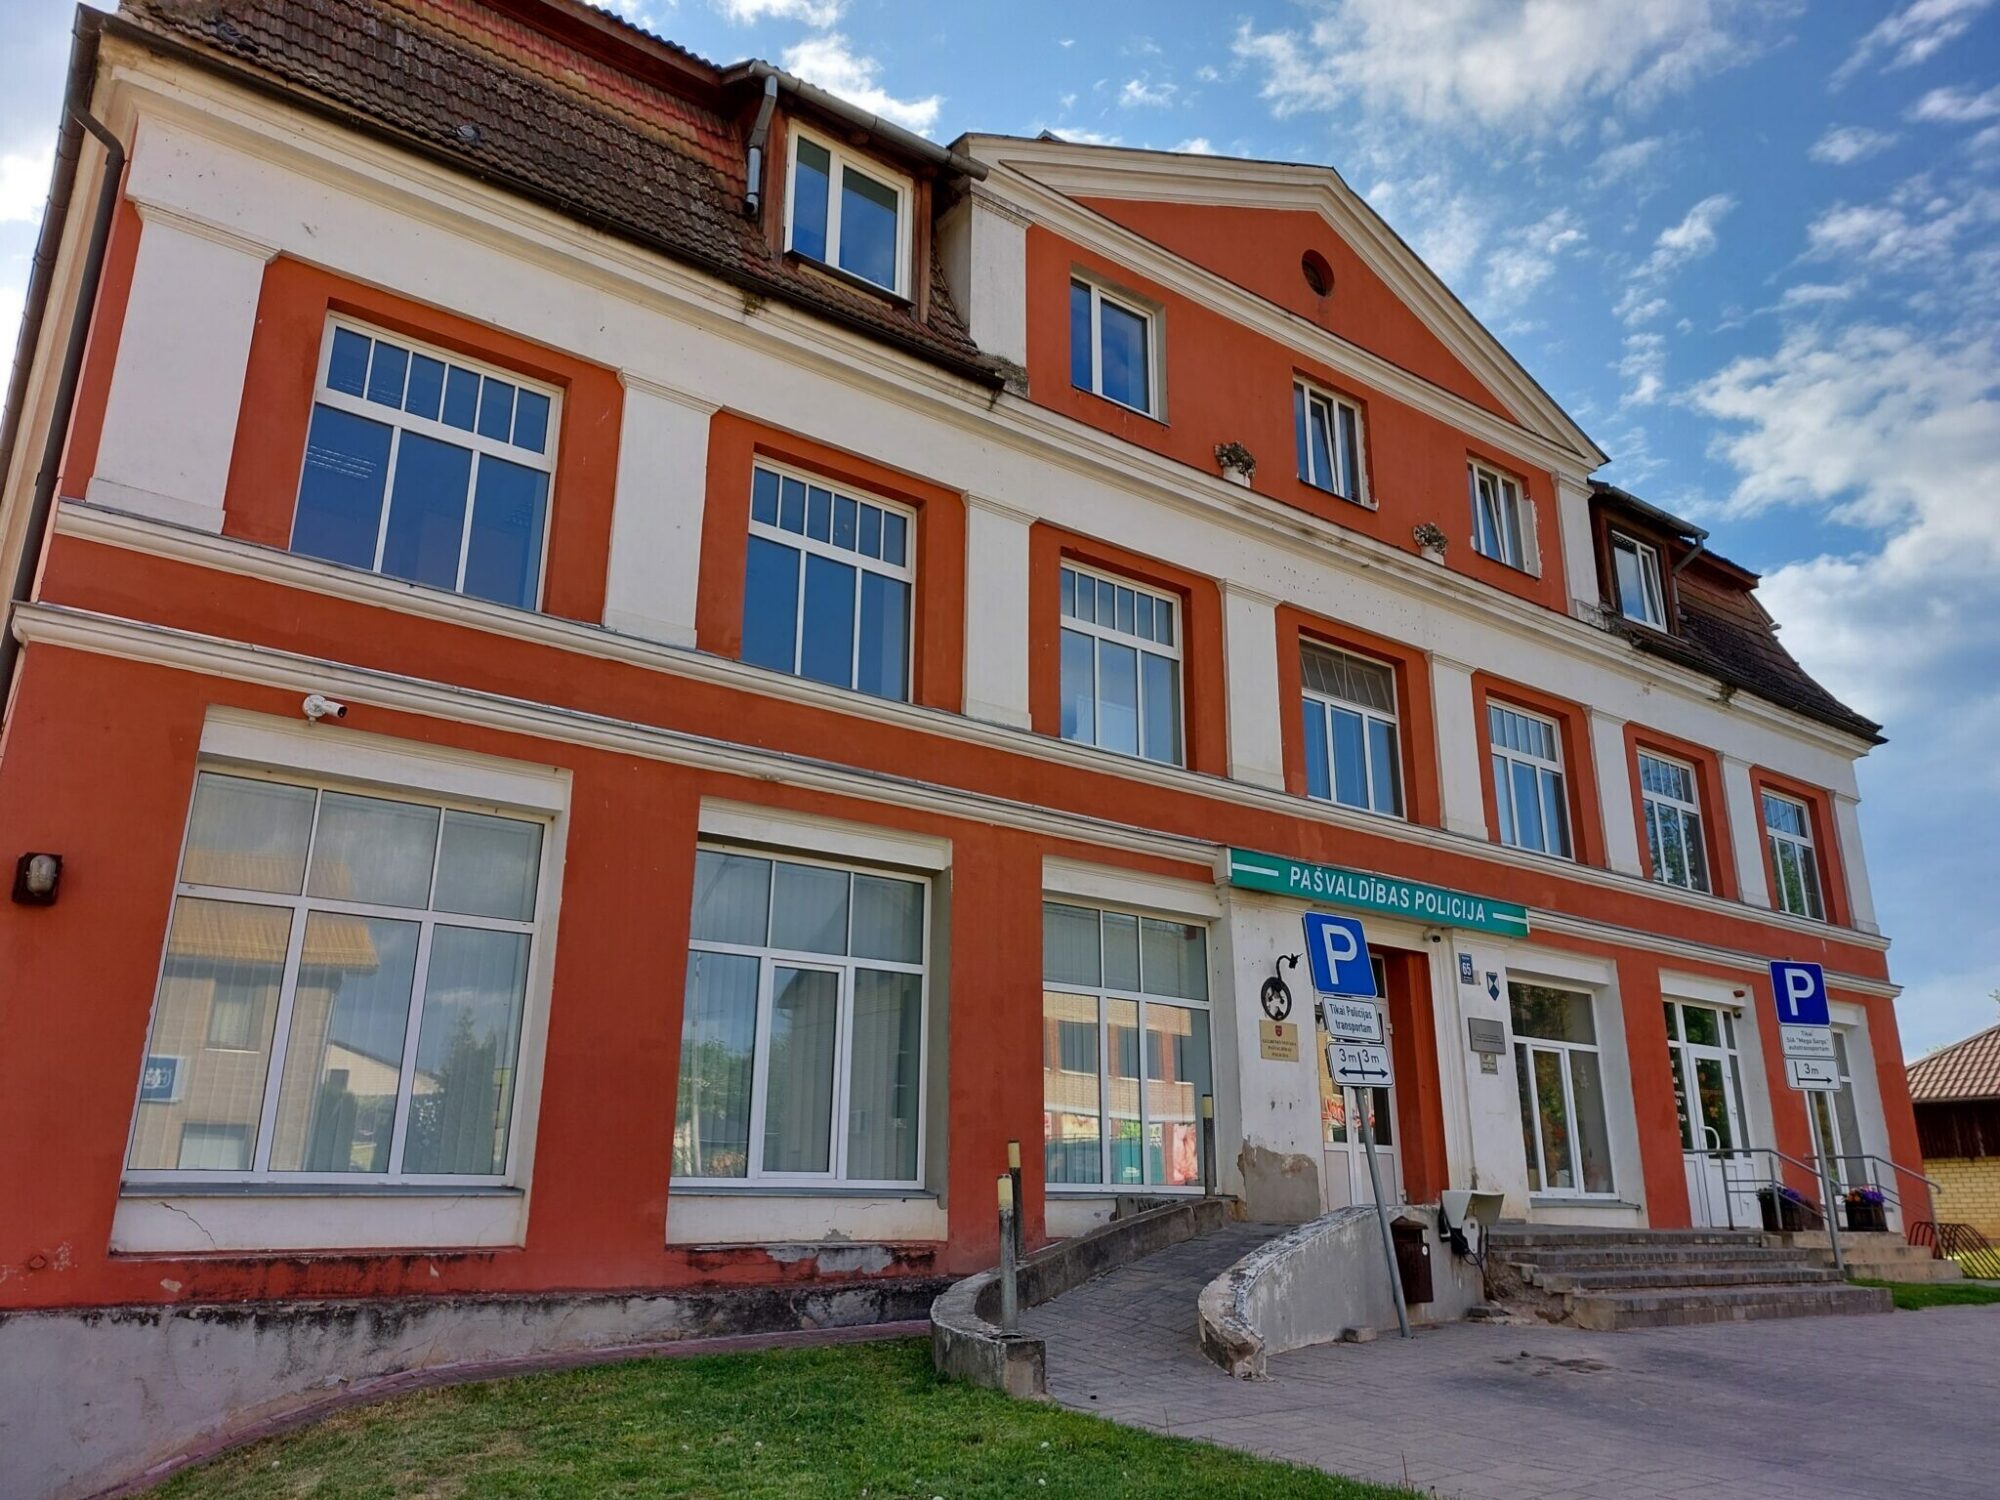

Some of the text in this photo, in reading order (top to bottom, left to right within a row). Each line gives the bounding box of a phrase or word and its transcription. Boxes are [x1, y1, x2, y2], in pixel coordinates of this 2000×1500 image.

[1290, 866, 1486, 923] PAŠVALDĪBAS POLICIJA
[1321, 924, 1358, 985] P
[1462, 963, 1472, 976] 65
[1784, 968, 1815, 1016] P
[1329, 1003, 1373, 1021] Tikai Policijas
[1335, 1020, 1373, 1034] transportam
